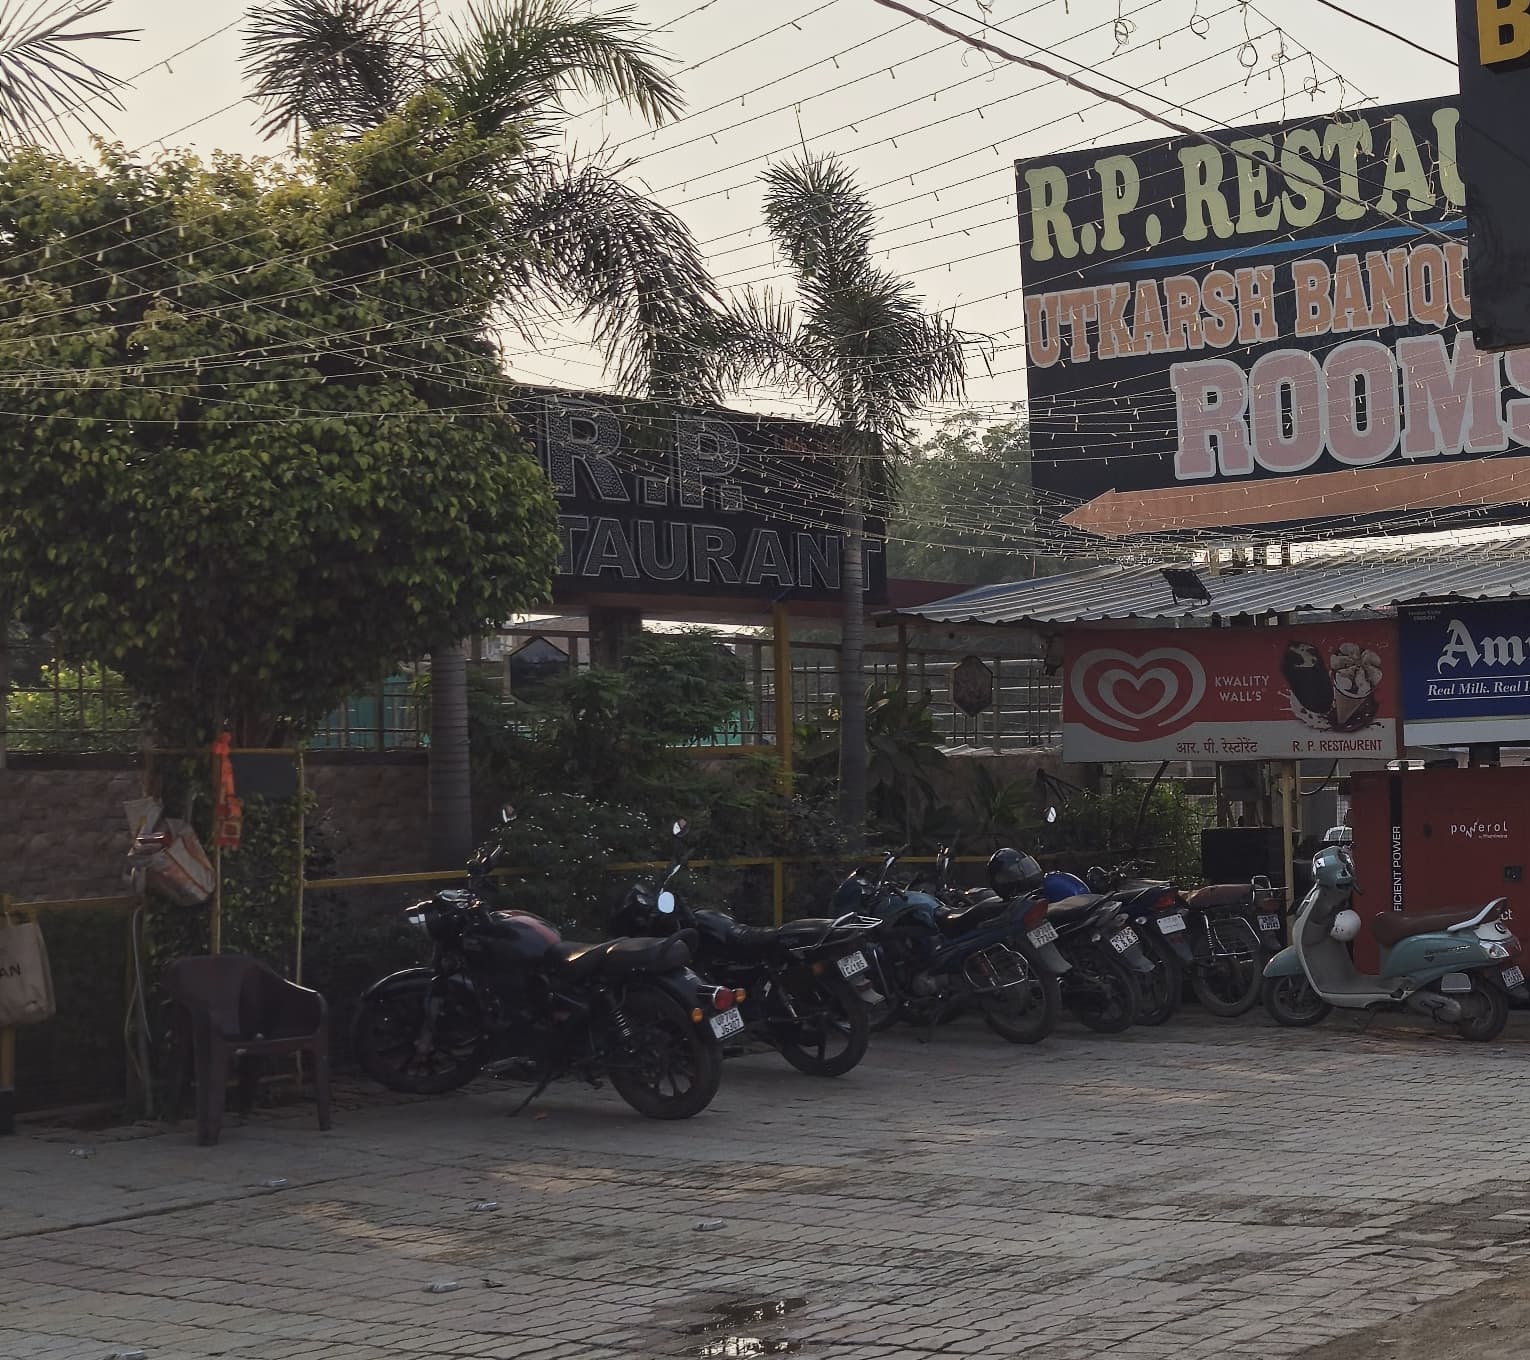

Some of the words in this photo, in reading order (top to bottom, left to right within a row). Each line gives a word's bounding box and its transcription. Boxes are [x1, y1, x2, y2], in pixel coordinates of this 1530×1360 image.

[1025, 265, 1279, 369] UTKARSH
[1214, 674, 1270, 689] KWALITY
[1427, 683, 1455, 697] Real
[1458, 682, 1491, 695] Milk.
[1493, 681, 1521, 693] Real
[1219, 690, 1263, 703] WALL'S
[1320, 739, 1383, 752] RESTAURENT
[1392, 825, 1402, 868] POWER
